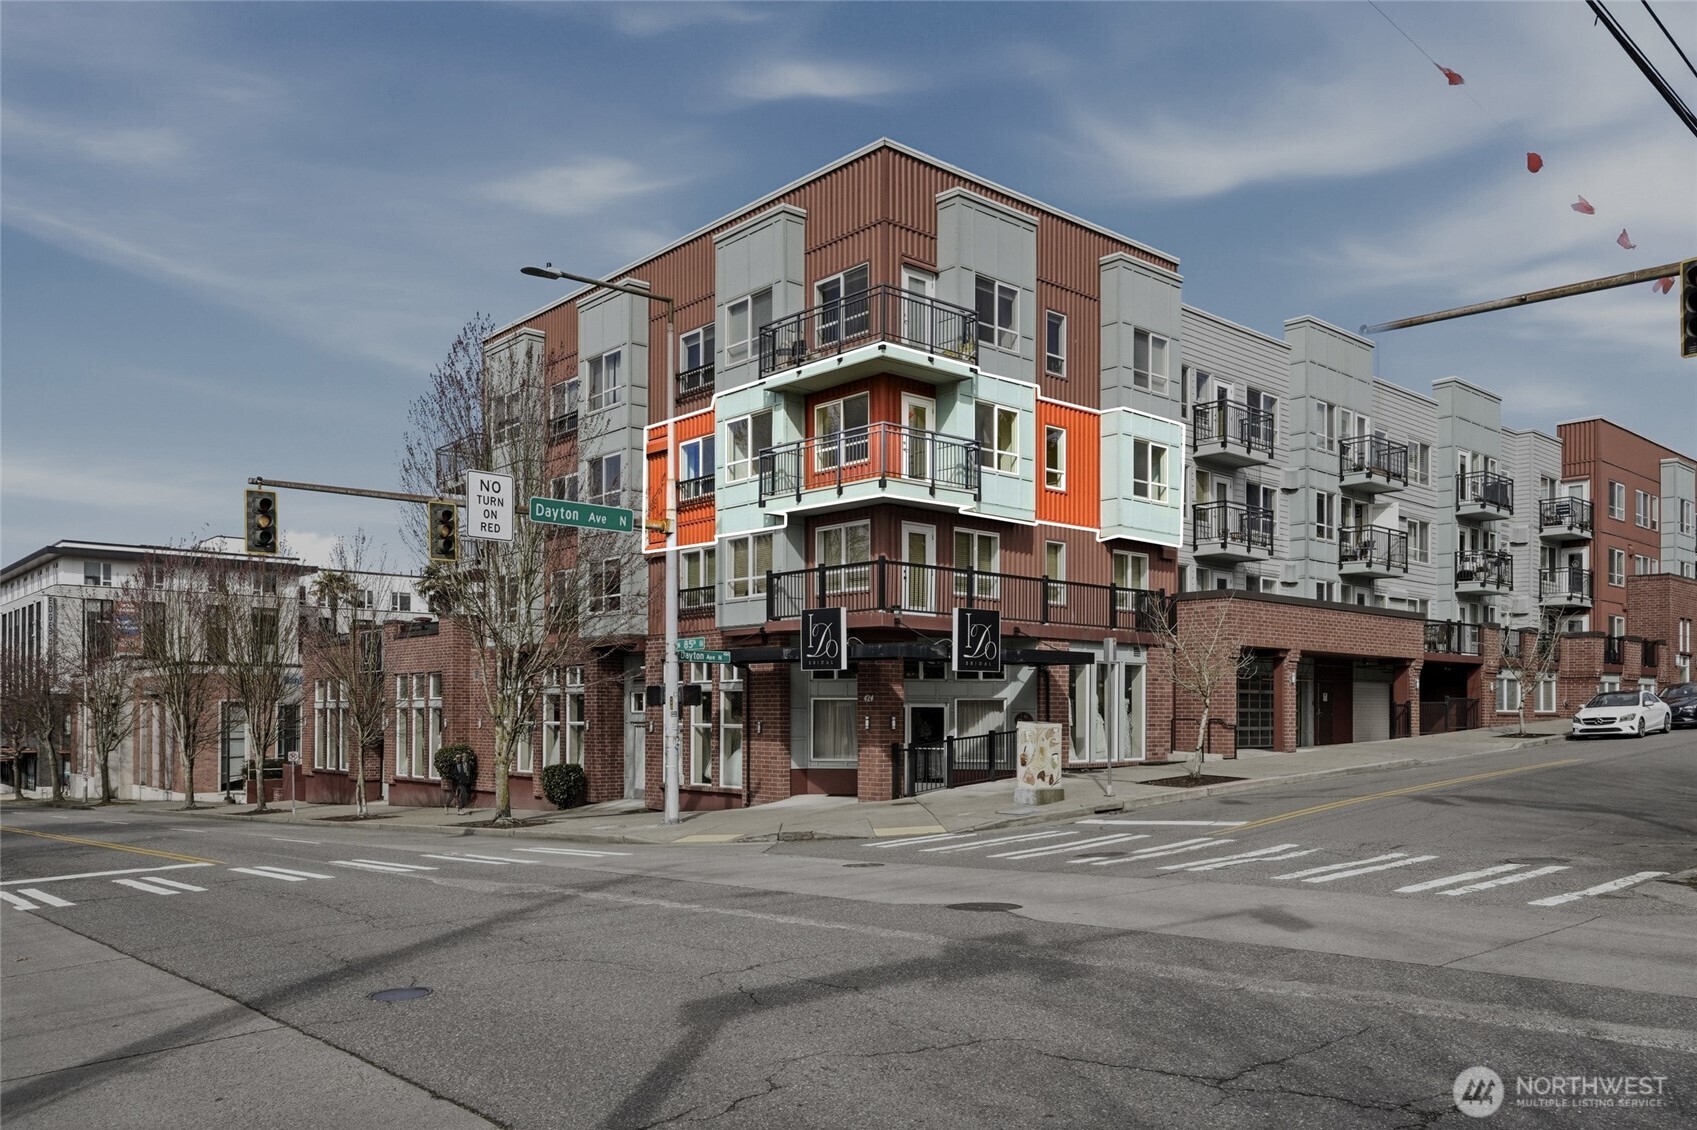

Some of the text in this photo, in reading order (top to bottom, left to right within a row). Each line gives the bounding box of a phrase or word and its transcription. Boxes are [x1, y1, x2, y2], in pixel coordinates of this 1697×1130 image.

[480, 479, 501, 493] NO
[476, 495, 504, 507] TURN
[483, 509, 498, 520] ON
[535, 503, 627, 527] Dayton Ave N
[480, 522, 501, 533] RED
[681, 650, 704, 661] Dayton
